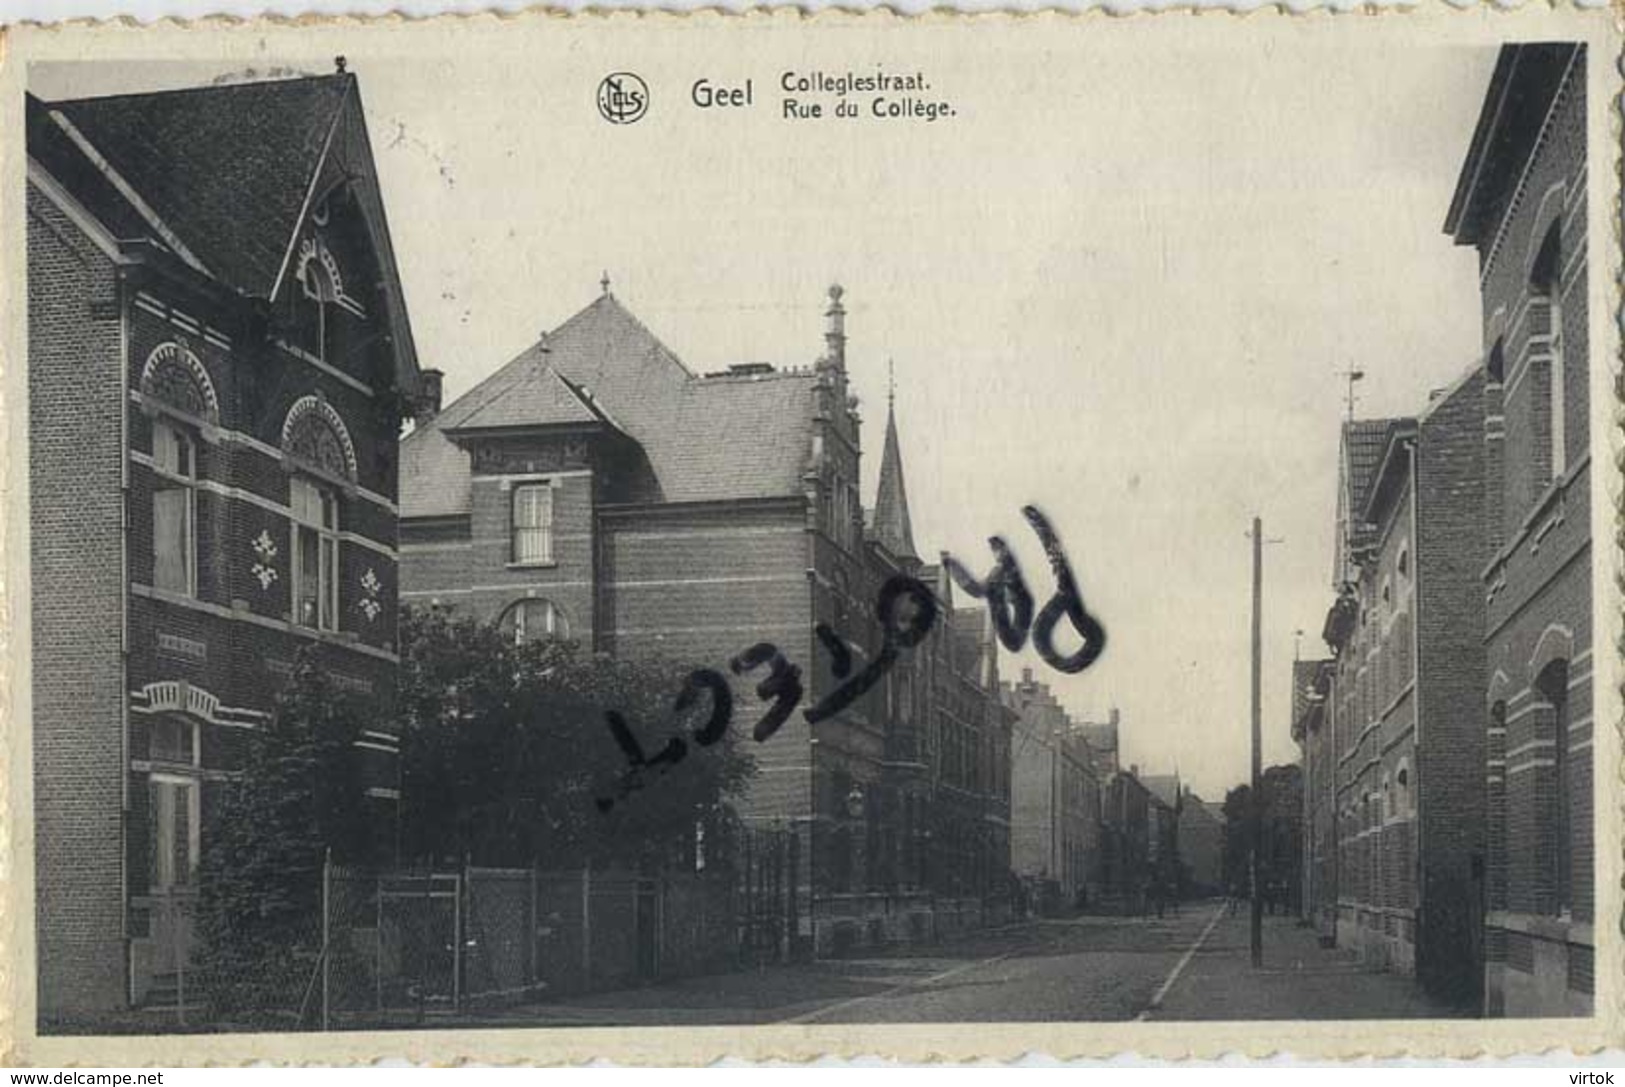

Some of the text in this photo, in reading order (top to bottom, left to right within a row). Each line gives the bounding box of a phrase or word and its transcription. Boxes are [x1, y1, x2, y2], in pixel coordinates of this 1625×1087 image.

[692, 79, 752, 107] Geel
[783, 97, 957, 121] Rue du Collège.
